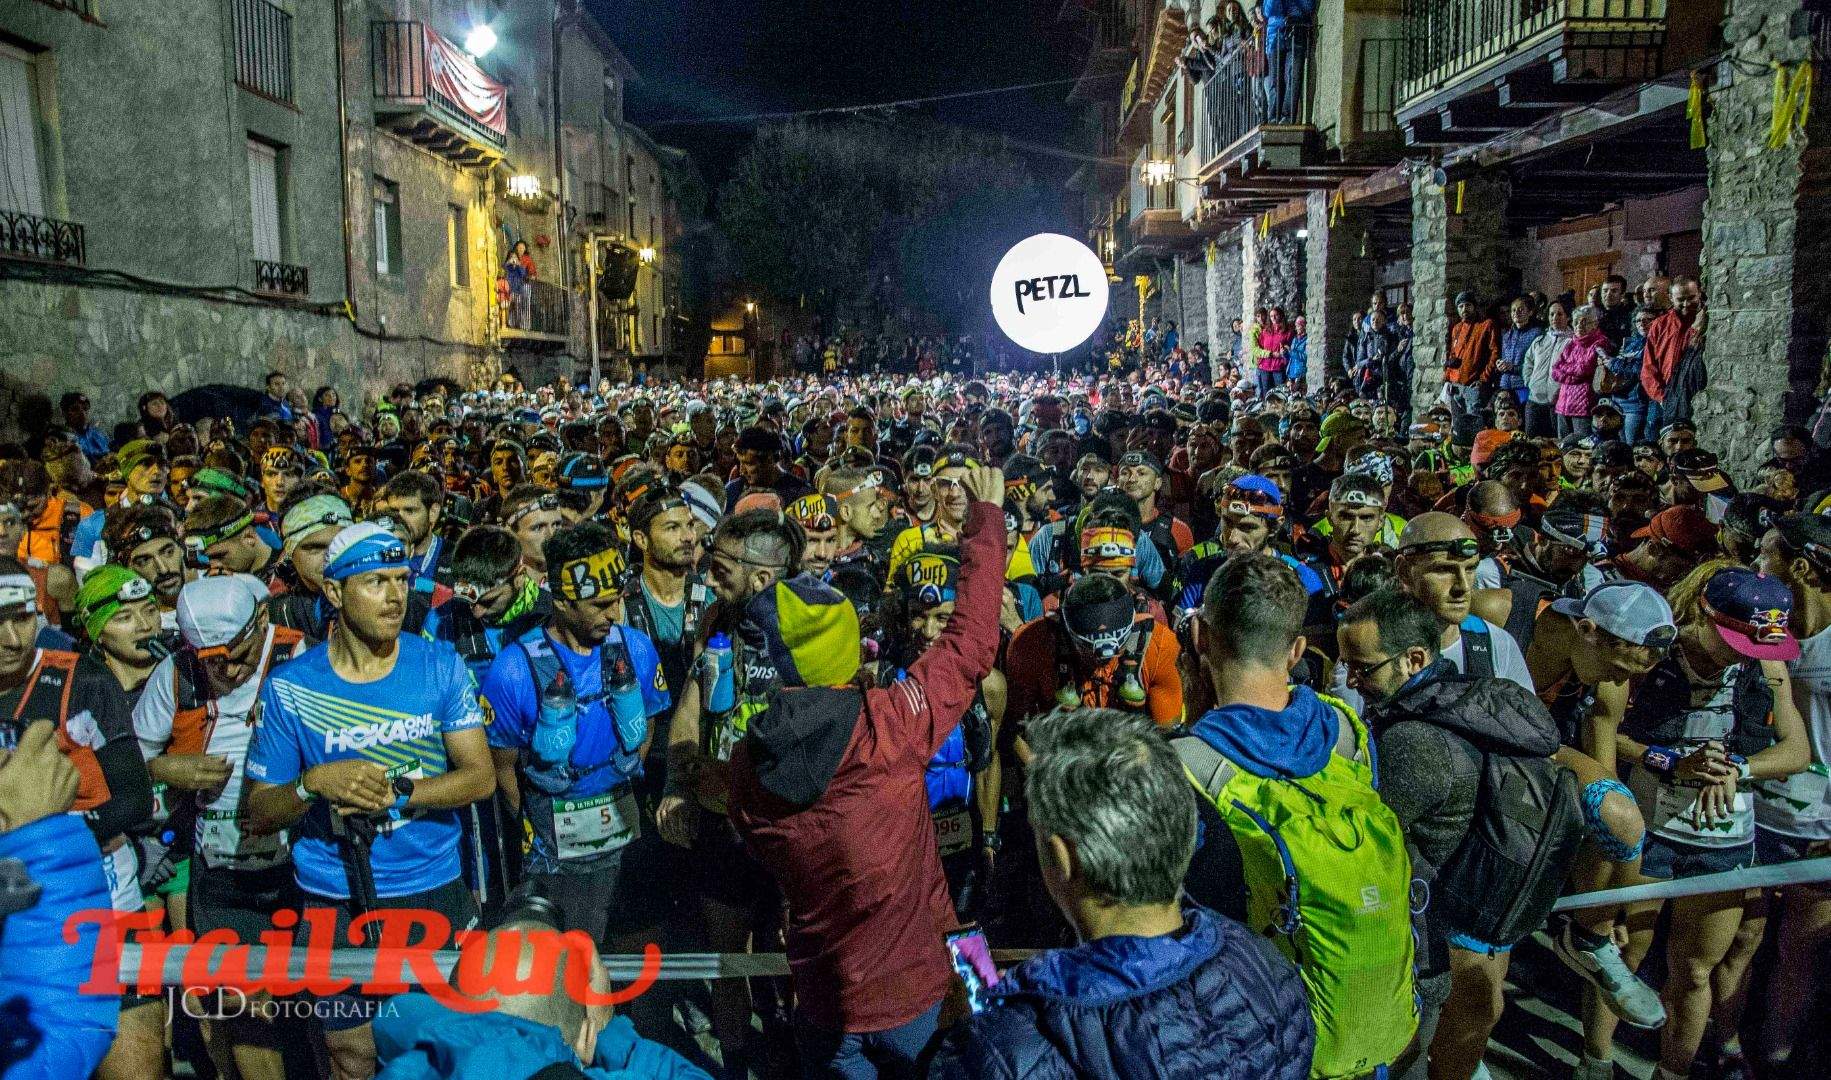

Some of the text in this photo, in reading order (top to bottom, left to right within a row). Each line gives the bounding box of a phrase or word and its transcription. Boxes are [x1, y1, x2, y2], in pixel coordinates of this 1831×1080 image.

[1015, 274, 1091, 315] PETZL
[324, 719, 403, 754] HOKA
[600, 806, 611, 825] 5
